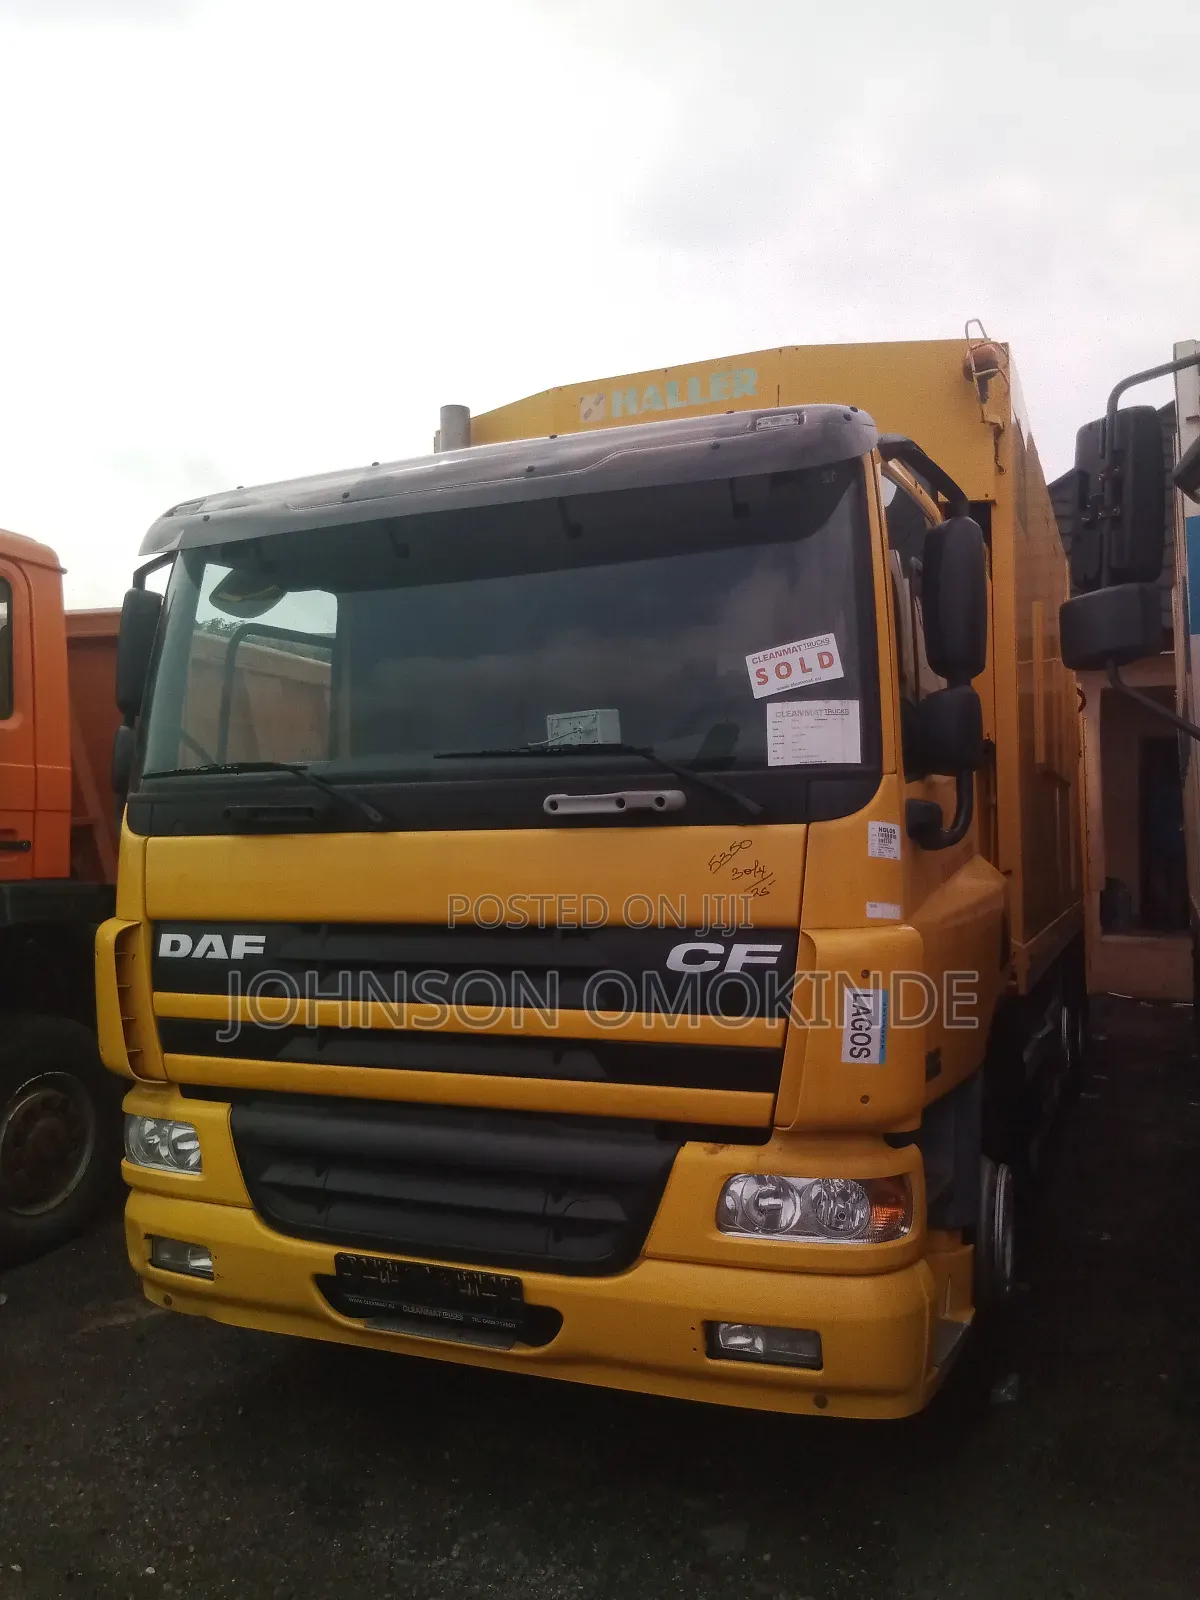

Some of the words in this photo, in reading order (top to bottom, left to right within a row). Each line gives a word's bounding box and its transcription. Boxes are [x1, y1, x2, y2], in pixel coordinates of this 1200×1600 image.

[611, 368, 758, 418] HALLER
[752, 645, 802, 665] CLEANMAT
[803, 638, 831, 651] TRUCKS
[755, 651, 835, 686] SOLD
[775, 708, 824, 718] CLEANMAT
[824, 708, 850, 716] TRUCKS
[708, 839, 753, 875] 5350
[158, 933, 266, 960] DAF
[665, 942, 782, 973] CF
[849, 993, 873, 1058] LAGOS
